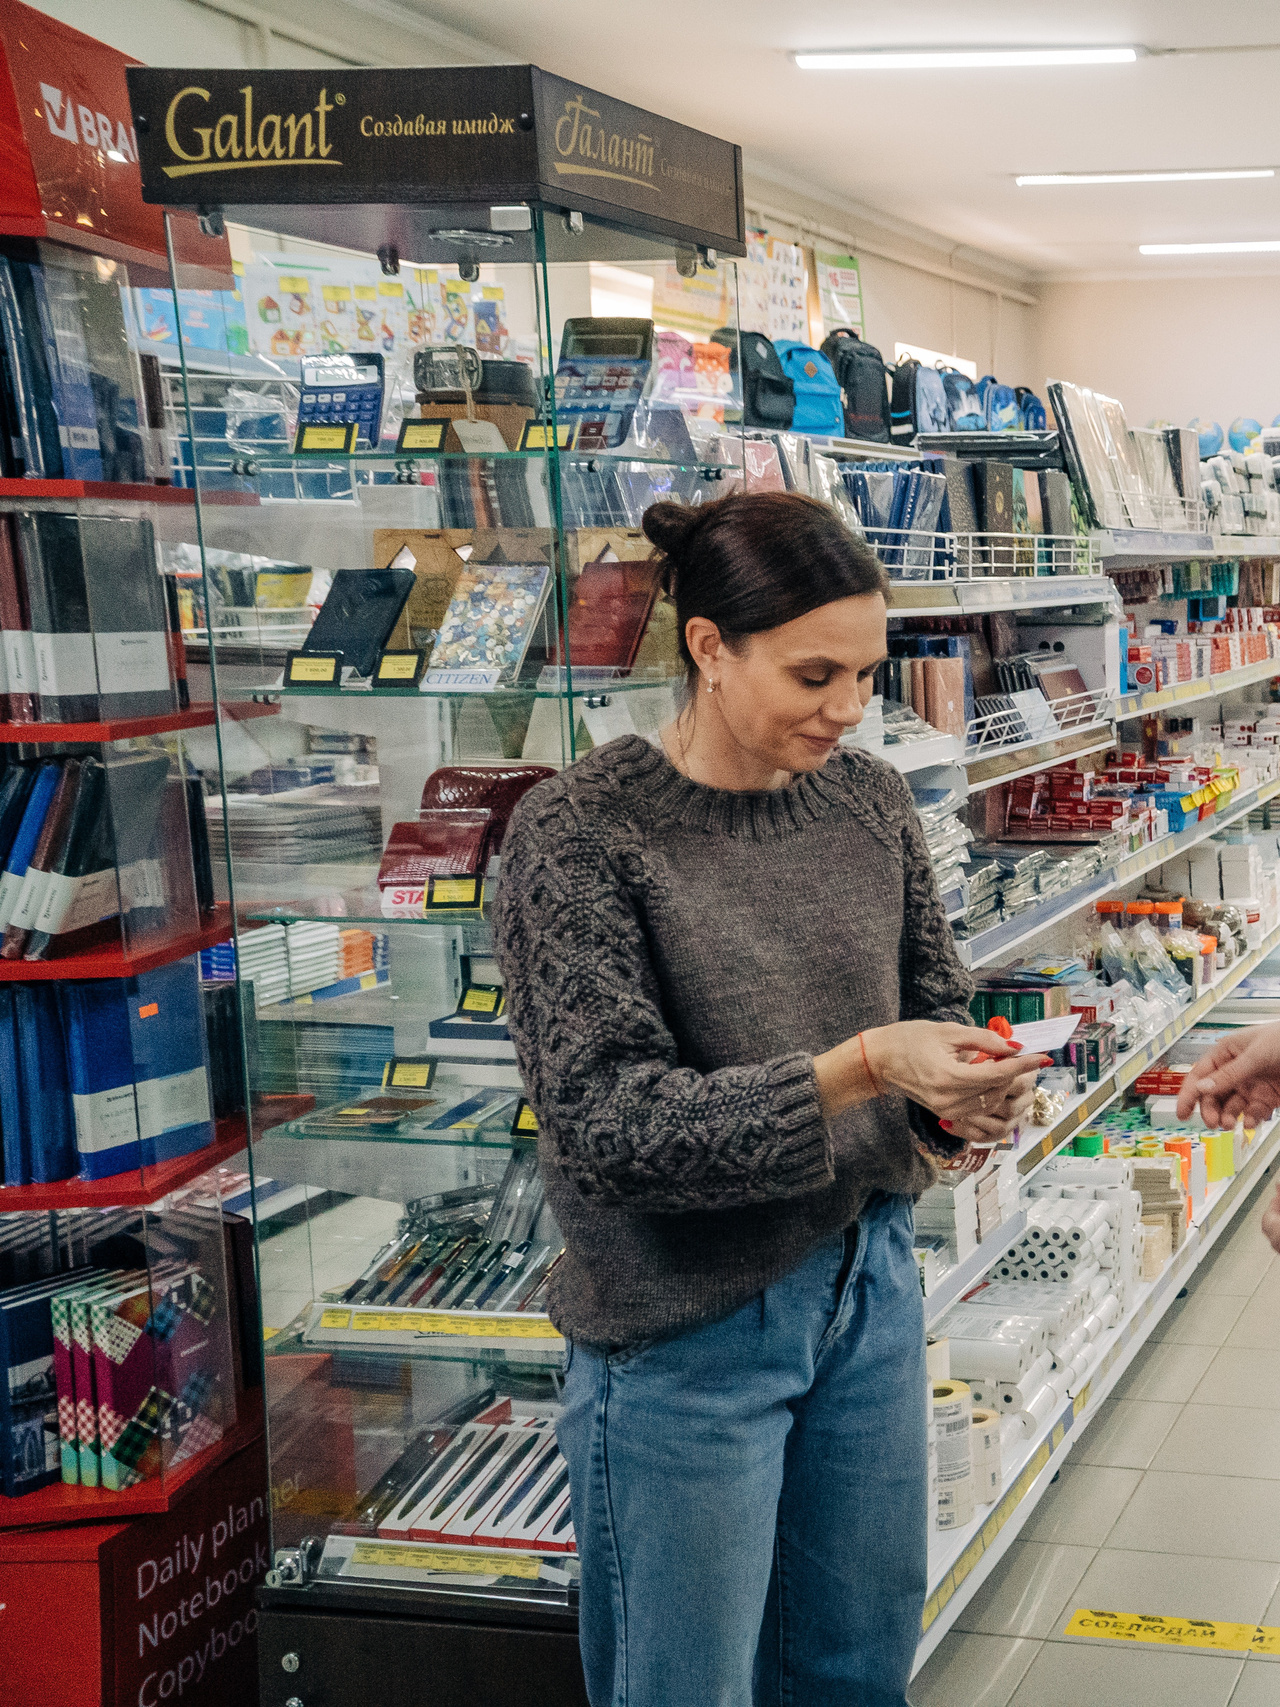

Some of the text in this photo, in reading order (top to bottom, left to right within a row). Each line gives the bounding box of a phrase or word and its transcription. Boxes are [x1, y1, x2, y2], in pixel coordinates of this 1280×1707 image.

[360, 113, 515, 137] Создавая имидж
[555, 96, 655, 177] Галант
[427, 673, 493, 686] CITIZEN
[138, 1534, 204, 1600] Daily
